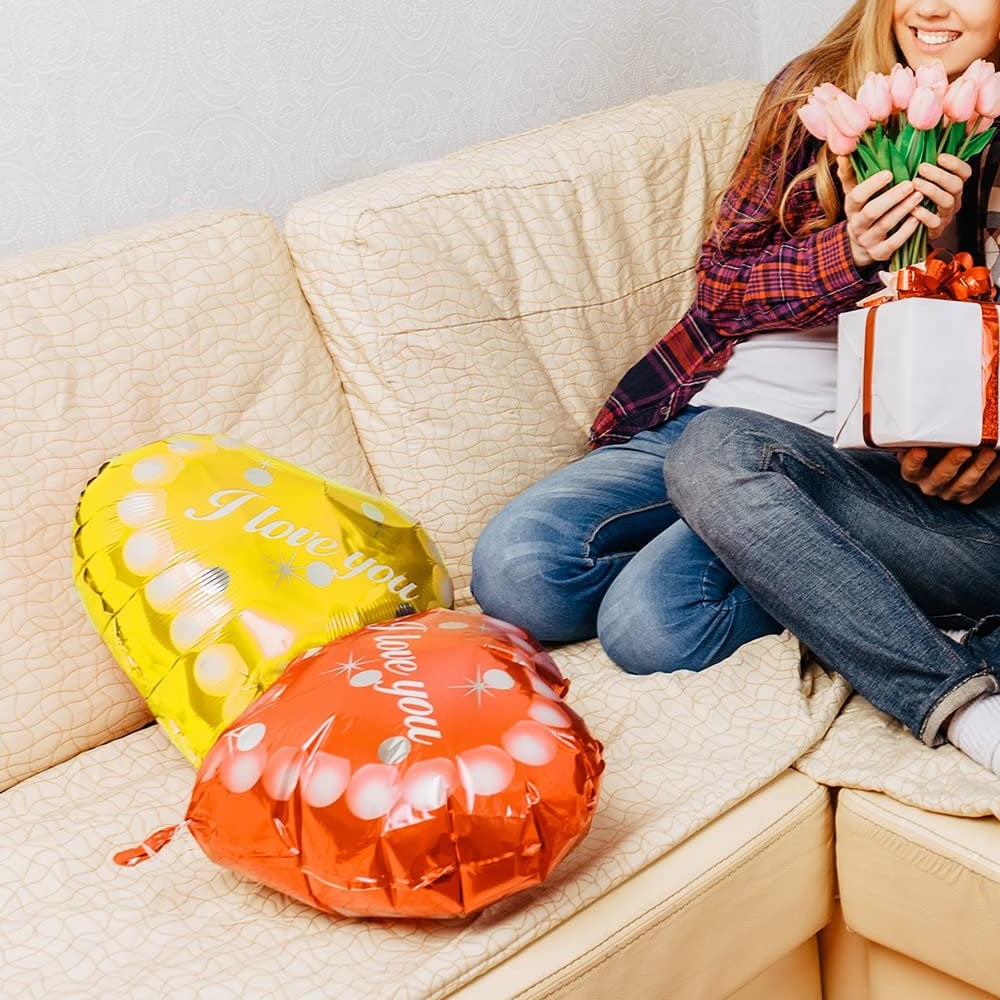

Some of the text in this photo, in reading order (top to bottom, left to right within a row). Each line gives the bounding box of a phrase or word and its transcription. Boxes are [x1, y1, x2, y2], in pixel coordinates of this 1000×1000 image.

[184, 489, 419, 601] I love you
[373, 634, 418, 676] love
[373, 680, 442, 746] you
